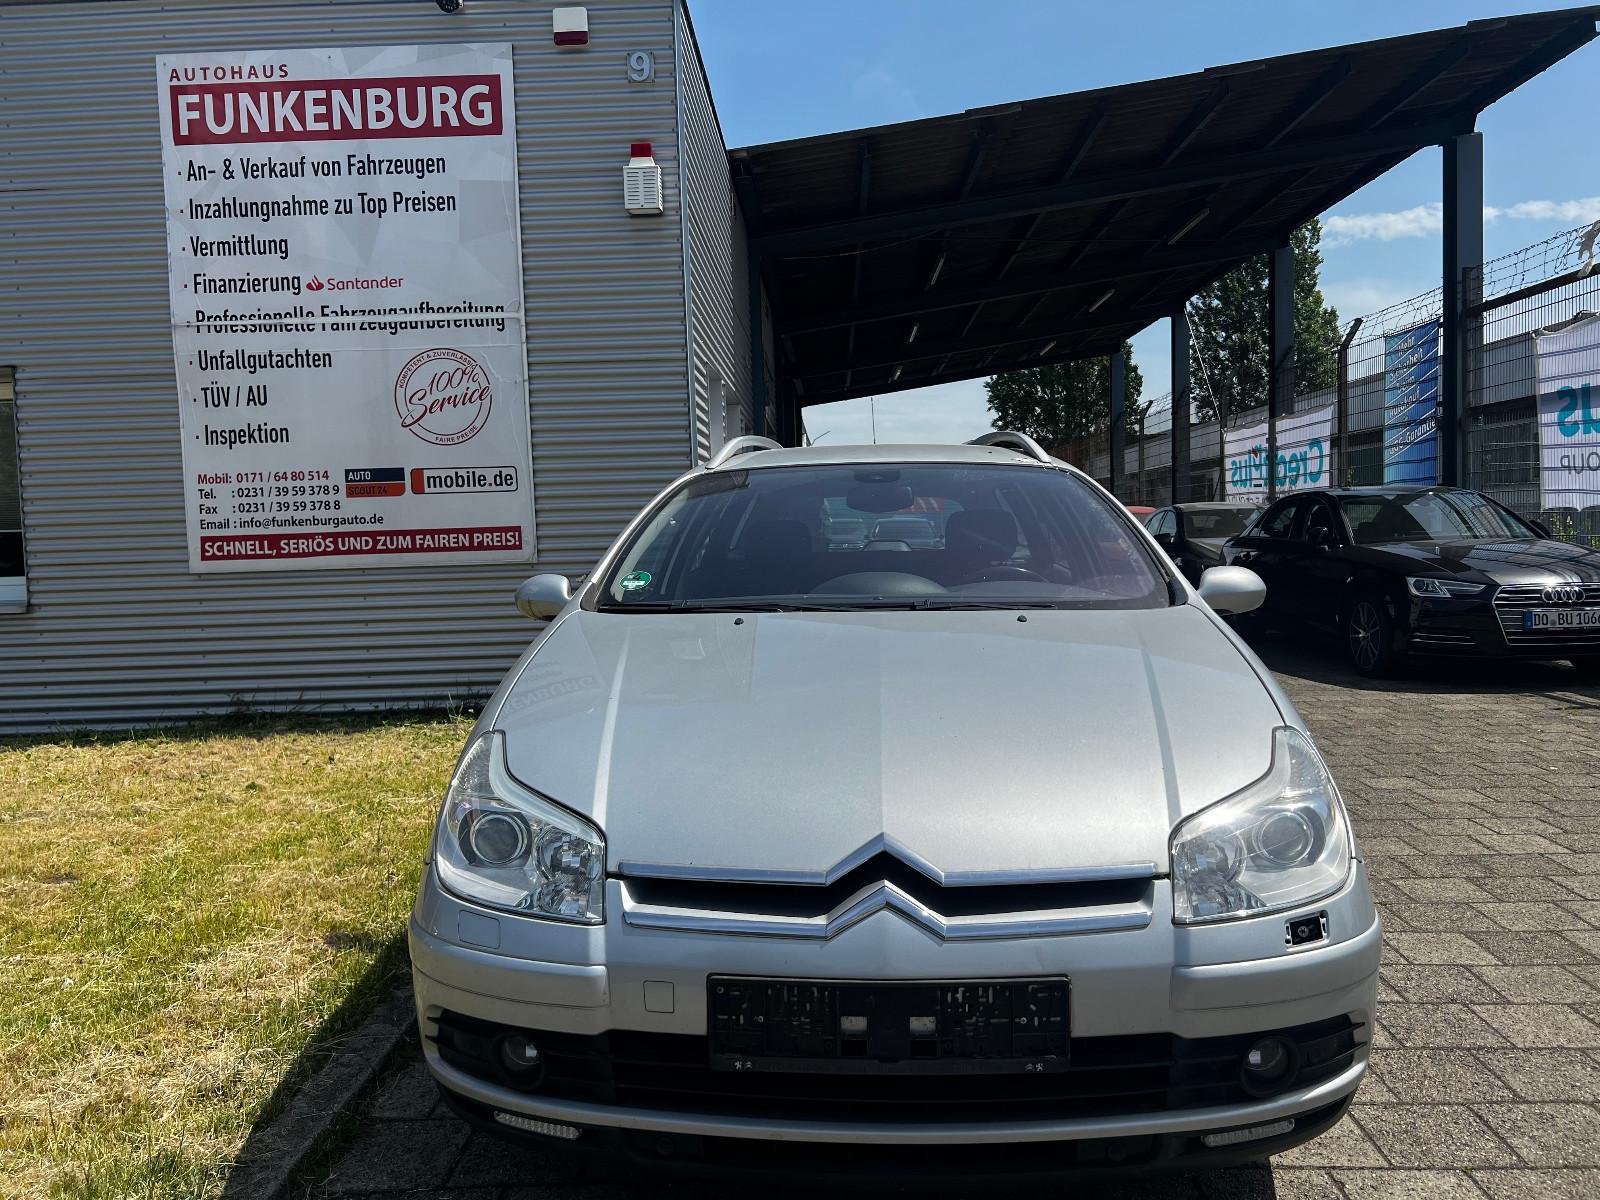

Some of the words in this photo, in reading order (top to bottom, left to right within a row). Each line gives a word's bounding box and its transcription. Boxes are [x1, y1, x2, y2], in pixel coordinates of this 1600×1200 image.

[169, 64, 289, 82] AUTOHAUS
[630, 52, 650, 82] 9
[177, 84, 493, 136] FUNKENBURG
[187, 160, 216, 181] An-
[222, 158, 235, 180] &
[240, 156, 306, 179] Verkauf
[311, 160, 342, 176] von
[347, 153, 446, 179] Fahrzeugen
[189, 194, 329, 222] Inzahlungnahme
[334, 198, 353, 214] zu
[357, 192, 387, 218] Top
[393, 190, 456, 212] Preisen
[190, 234, 288, 260] Vermittlung
[193, 272, 301, 295] Finanzierung
[327, 276, 404, 291] Santander
[195, 306, 316, 333] Professionelle
[320, 301, 505, 335] Fahrzeugaufbereitung
[198, 348, 332, 374] Unfallgutachten
[428, 363, 479, 395] 100%
[200, 381, 230, 408] TÜV
[236, 386, 240, 407] /
[247, 385, 268, 406] AU
[401, 385, 492, 428] Service
[205, 422, 289, 450] Inspektion
[435, 435, 456, 443] FAIRE
[457, 424, 478, 440] PREISE
[197, 473, 232, 485] Mobil:
[236, 472, 263, 483] 0171
[273, 471, 288, 482] 64
[290, 471, 305, 481] 80
[308, 470, 329, 480] 514
[348, 471, 371, 481] AUTO
[426, 470, 514, 489] mobile.de
[198, 488, 217, 499] Tel.
[274, 486, 289, 497] 39
[291, 485, 306, 496] 59
[349, 486, 375, 496] SCOUT
[199, 504, 218, 515] Fax
[276, 501, 290, 512] 39
[293, 501, 307, 511] 59
[200, 518, 230, 530] Email
[239, 513, 384, 529] info@funkenburgauto.de
[204, 540, 277, 556] SCHNELL,
[280, 536, 335, 554] SERIÖS
[338, 537, 373, 551] UND
[376, 535, 412, 550] ZUM
[415, 533, 470, 549] FAIREN
[473, 531, 520, 547] PREIS!
[1534, 613, 1549, 626] DO
[1558, 612, 1573, 626] BU
